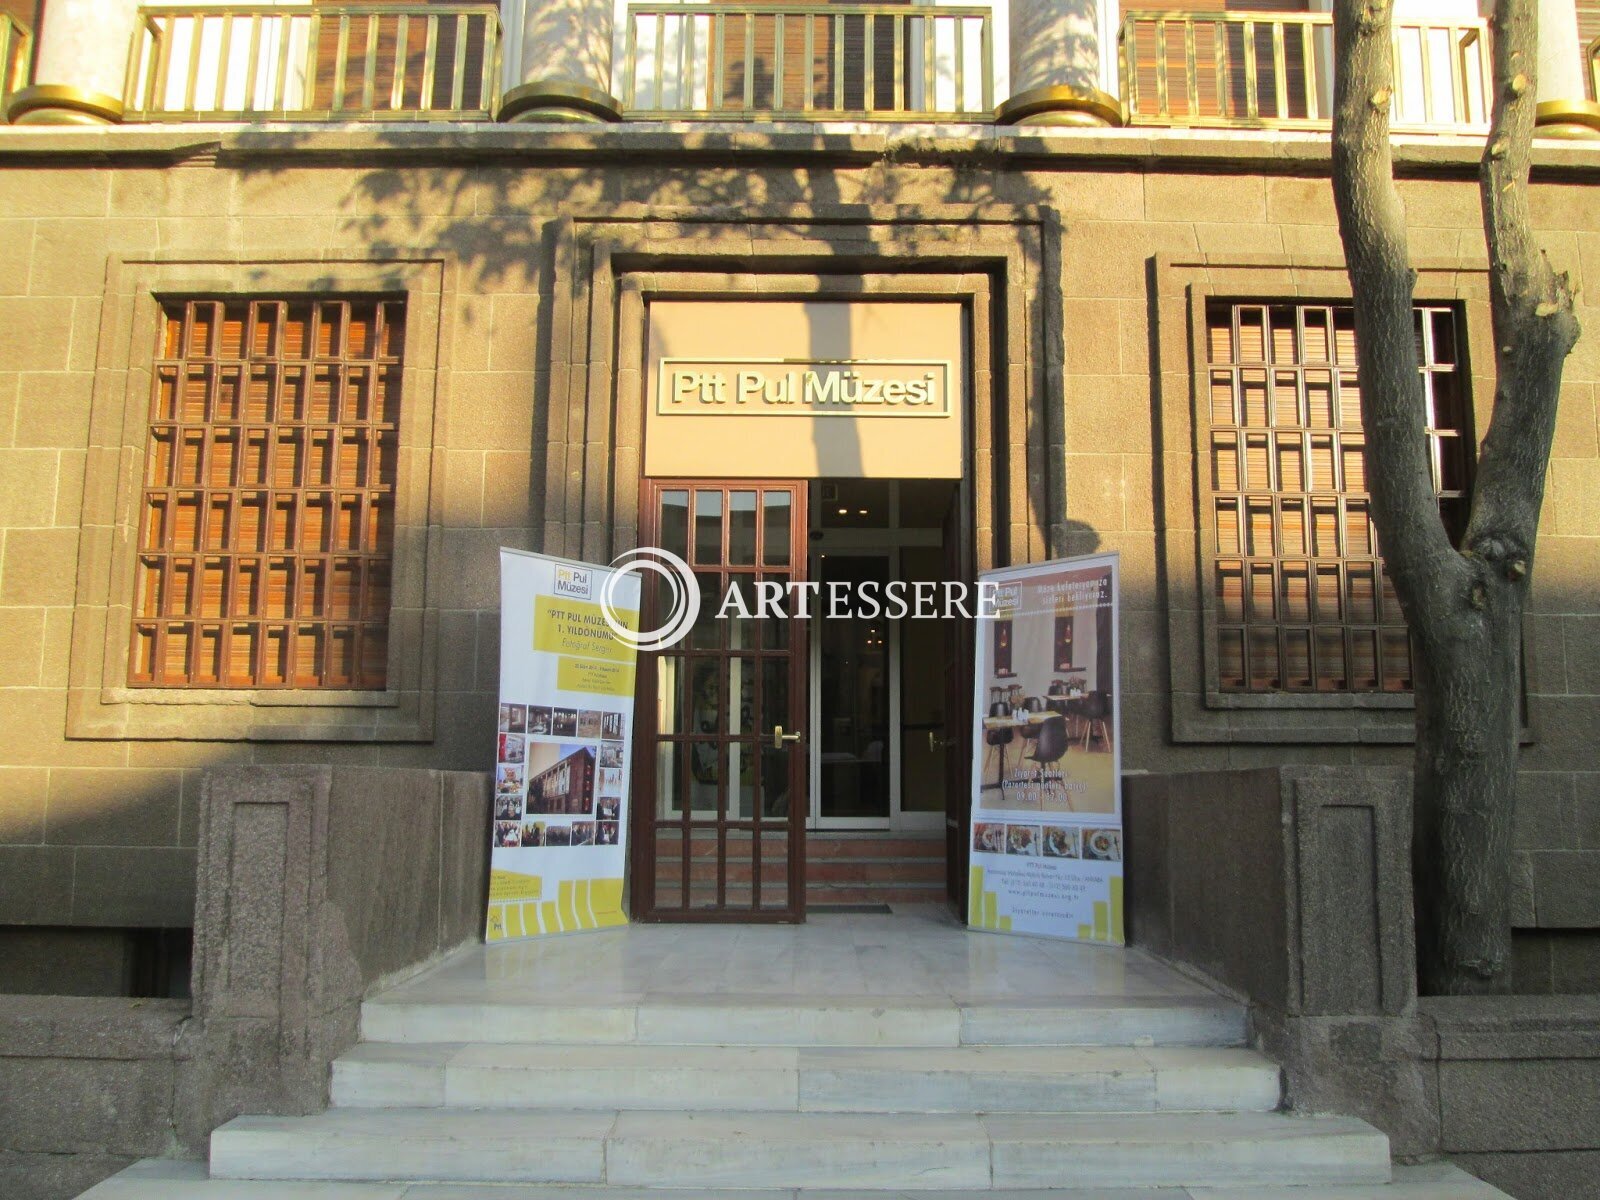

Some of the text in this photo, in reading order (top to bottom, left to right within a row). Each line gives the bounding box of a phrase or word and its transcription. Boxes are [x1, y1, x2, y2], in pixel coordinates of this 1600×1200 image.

[672, 370, 935, 405] Ptt Pul Müzesi
[557, 569, 588, 584] Ptt Pul
[557, 580, 589, 595] Müzesi
[567, 612, 582, 623] PUL
[557, 623, 565, 634] 1.
